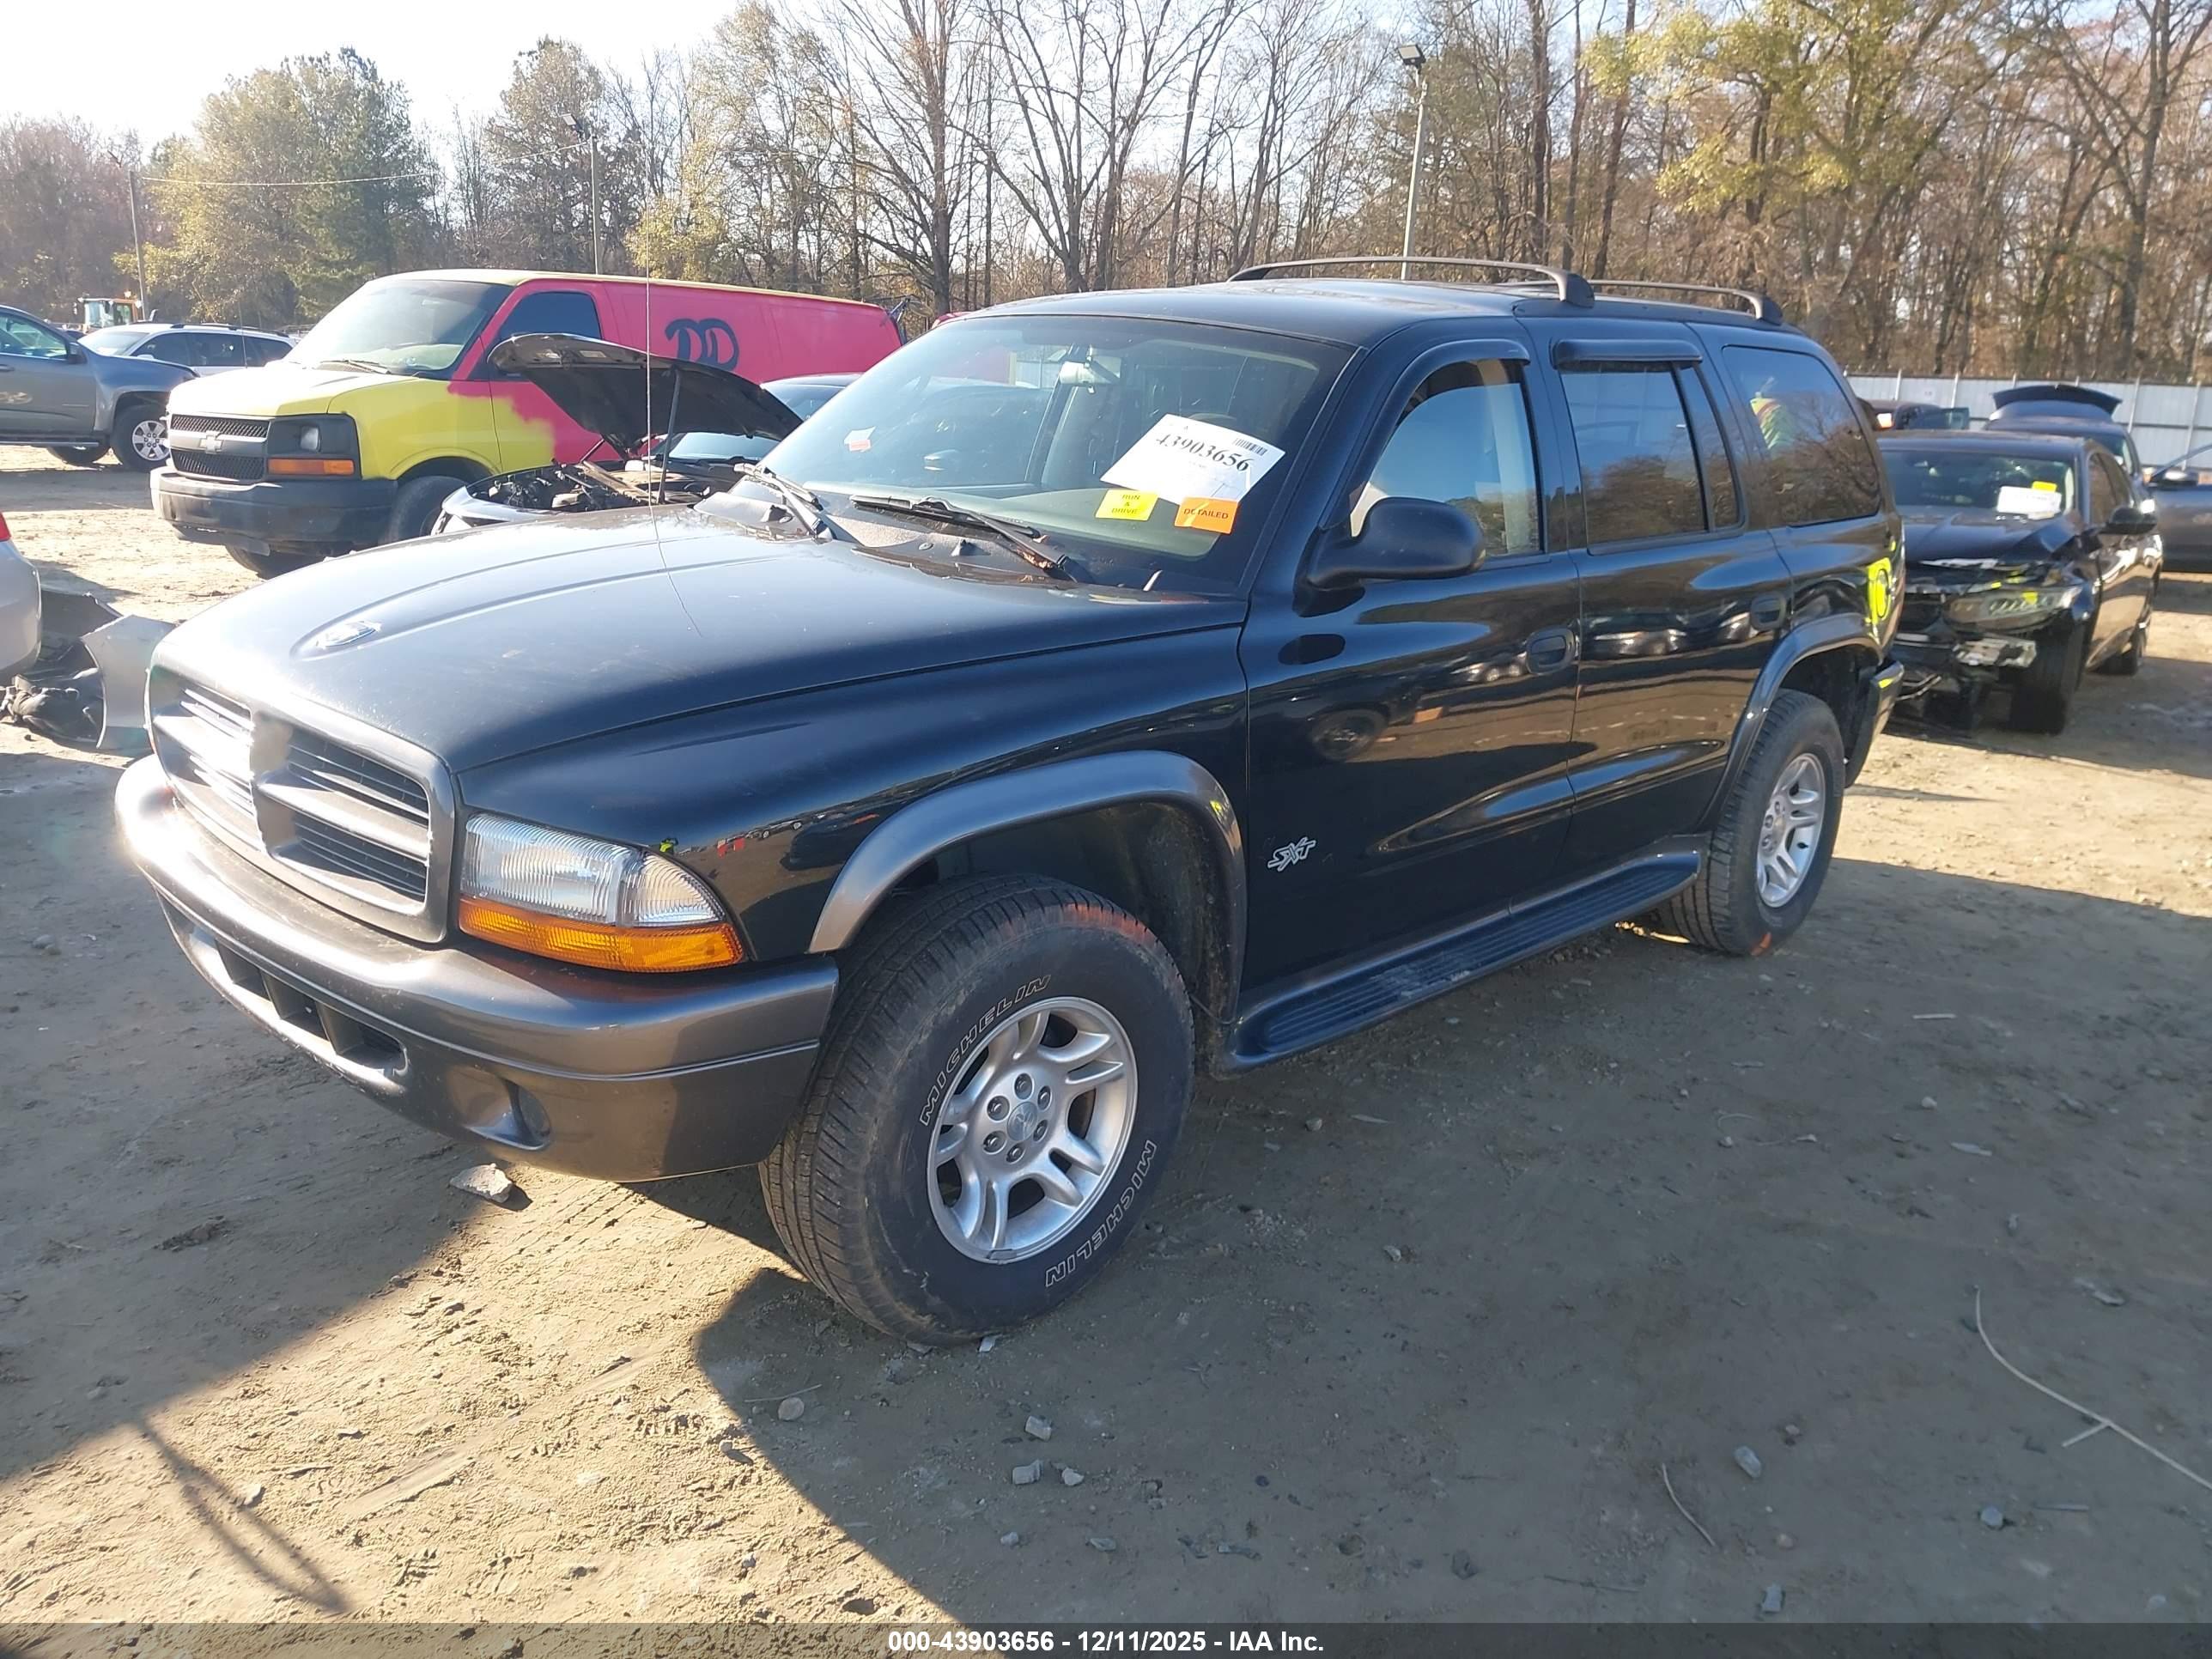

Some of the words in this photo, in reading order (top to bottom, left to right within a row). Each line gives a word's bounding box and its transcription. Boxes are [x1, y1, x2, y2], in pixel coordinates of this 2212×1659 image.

[1156, 433, 1255, 471] 43903656
[1267, 836, 1316, 872] SXT
[920, 975, 1052, 1127] MICHELIN
[1045, 1139, 1157, 1287] MICHELIN
